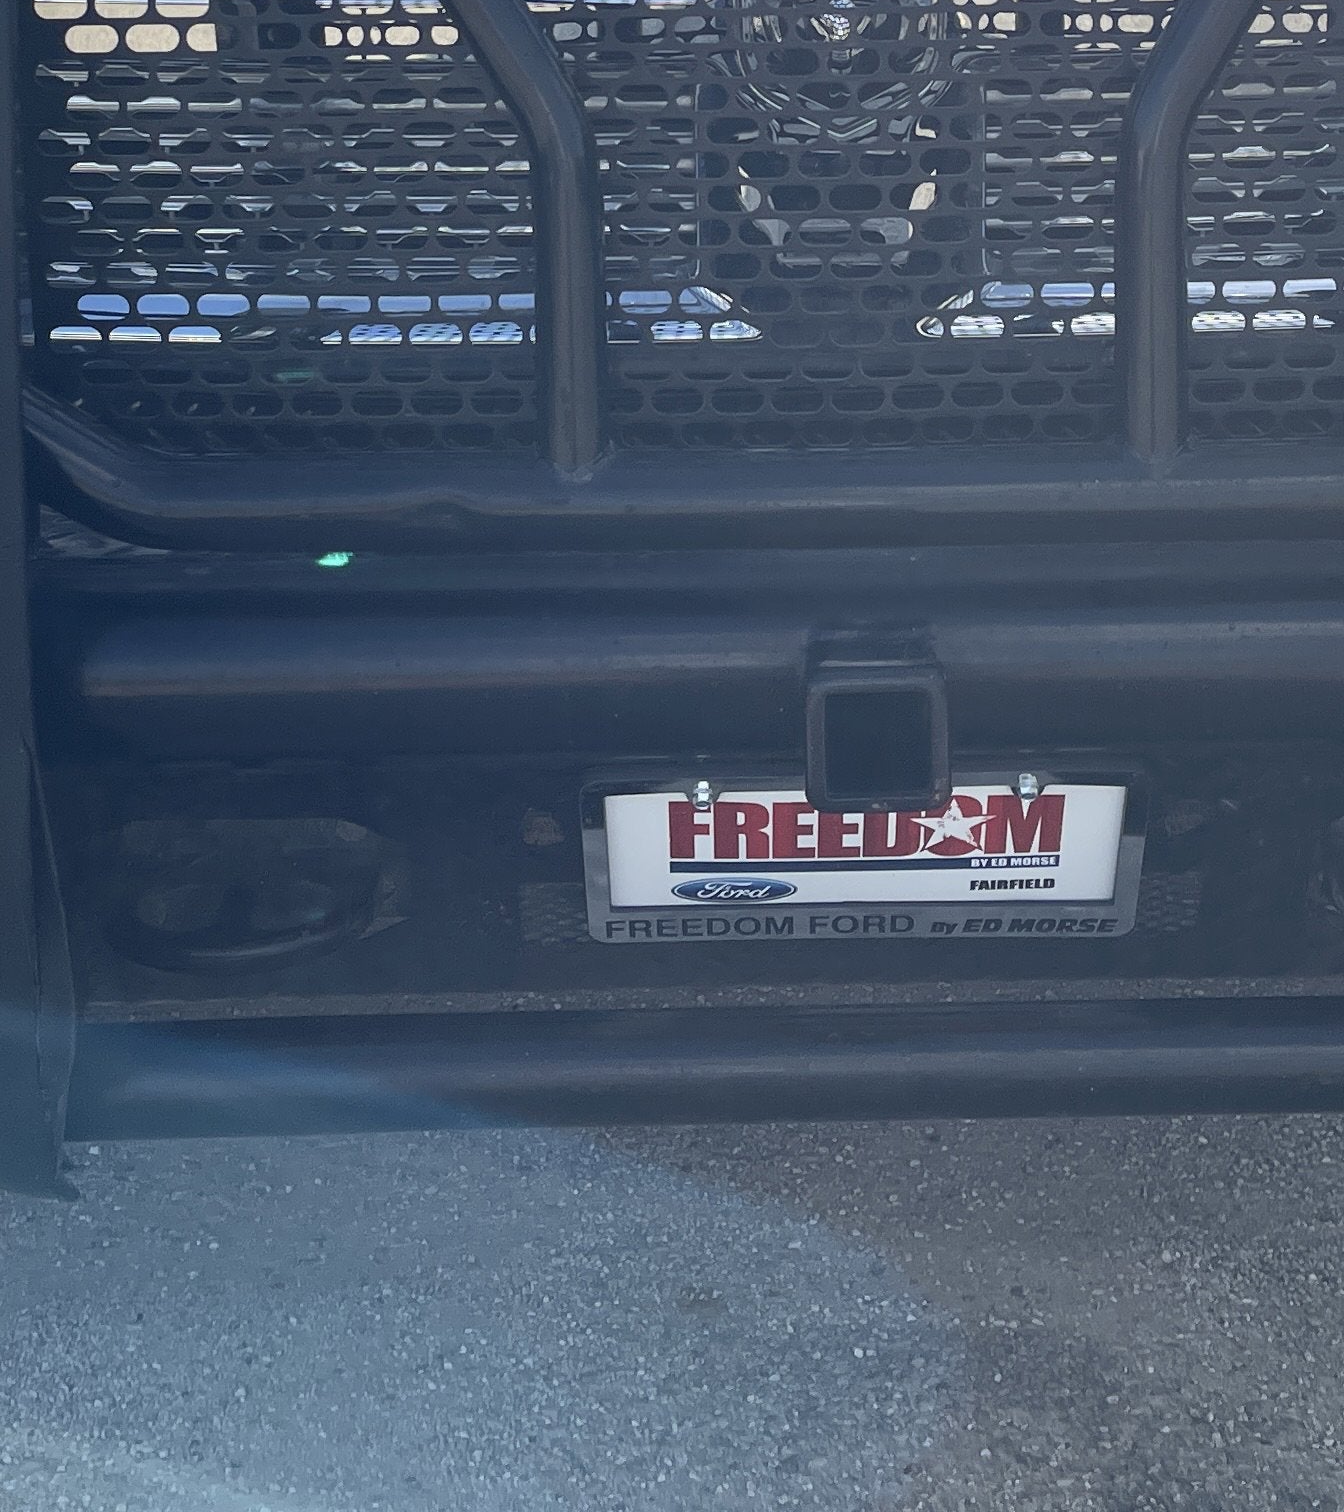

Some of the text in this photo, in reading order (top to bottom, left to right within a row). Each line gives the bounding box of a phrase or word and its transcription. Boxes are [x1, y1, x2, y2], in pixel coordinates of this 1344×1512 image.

[669, 795, 1065, 858] FREEDOM
[970, 855, 1057, 868] BY ED MORSE
[697, 880, 770, 899] Ford
[969, 877, 1056, 891] FAIRFIELD
[605, 915, 795, 939] FREEDOM
[809, 914, 916, 935] FORD
[961, 918, 1003, 934] ED
[1007, 918, 1118, 933] MORSE
